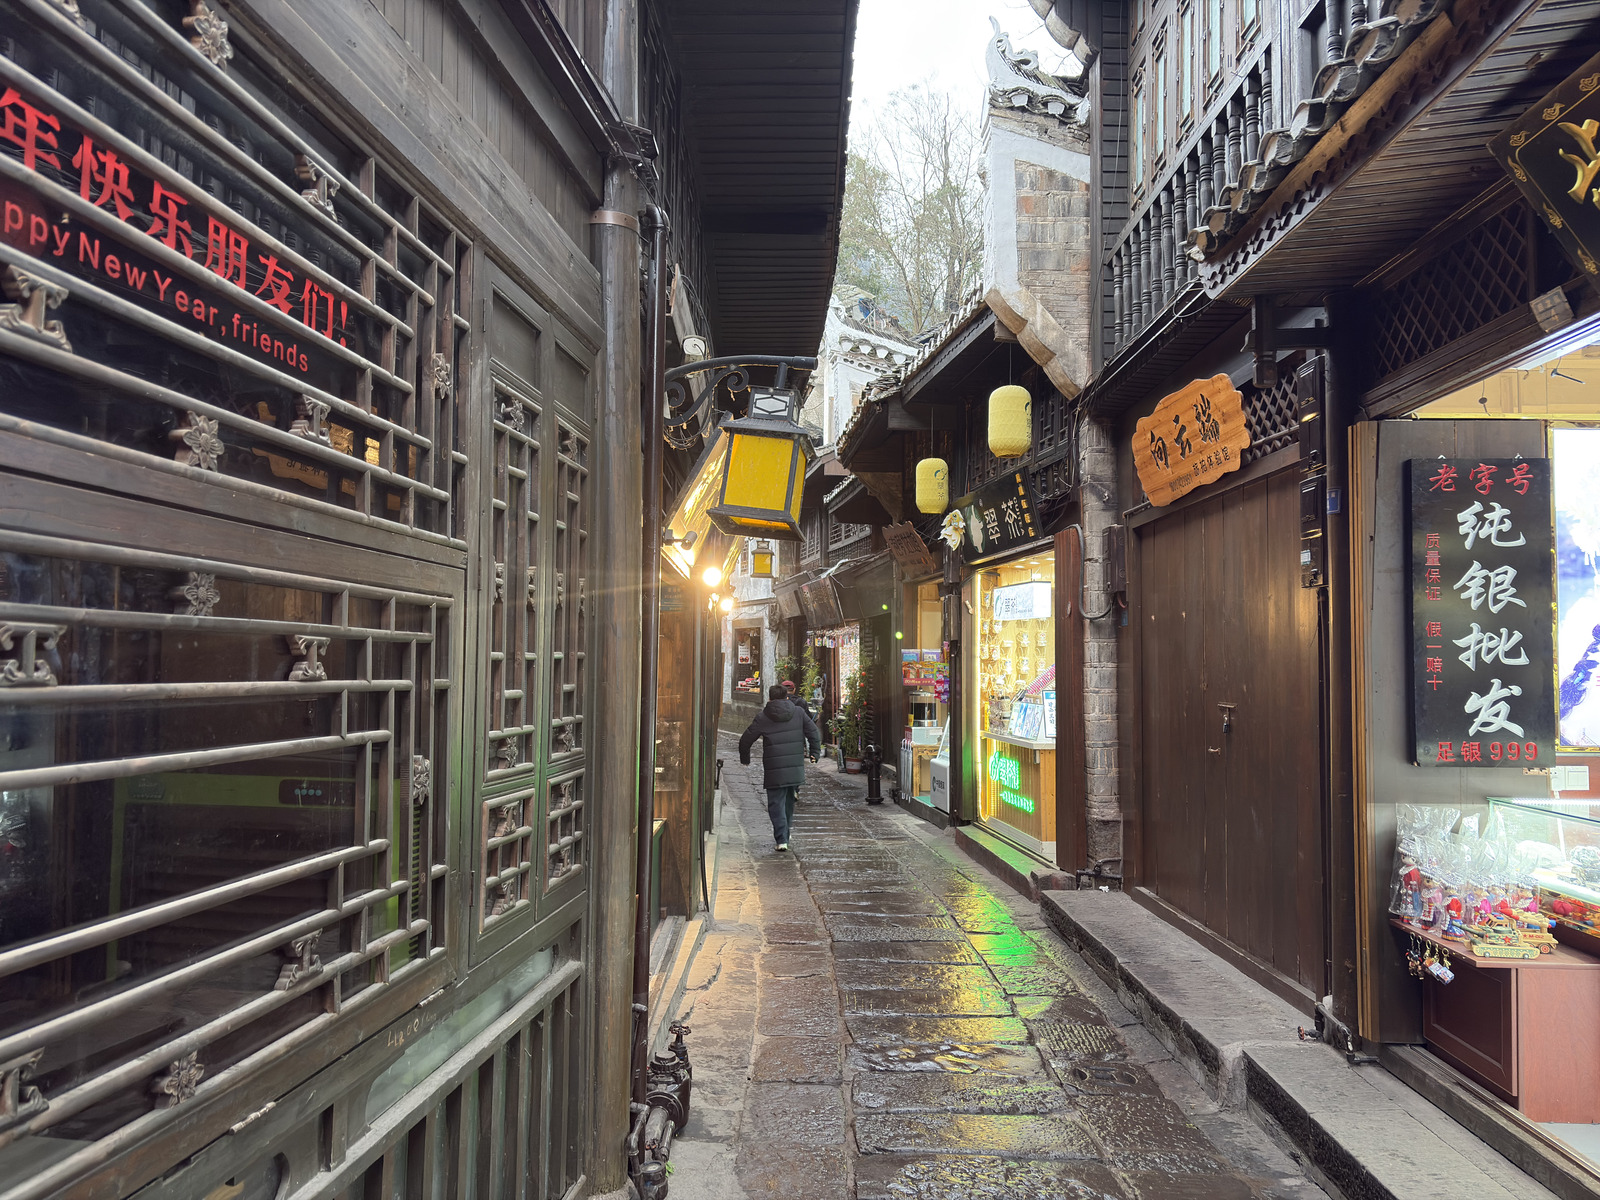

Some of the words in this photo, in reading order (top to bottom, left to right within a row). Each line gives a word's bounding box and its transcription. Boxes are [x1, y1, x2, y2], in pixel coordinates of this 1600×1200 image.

[1429, 463, 1534, 497] 老字号
[1424, 532, 1442, 602] 质量保证
[1452, 500, 1530, 739] 纯银批发
[1425, 620, 1444, 691] 假一赔十
